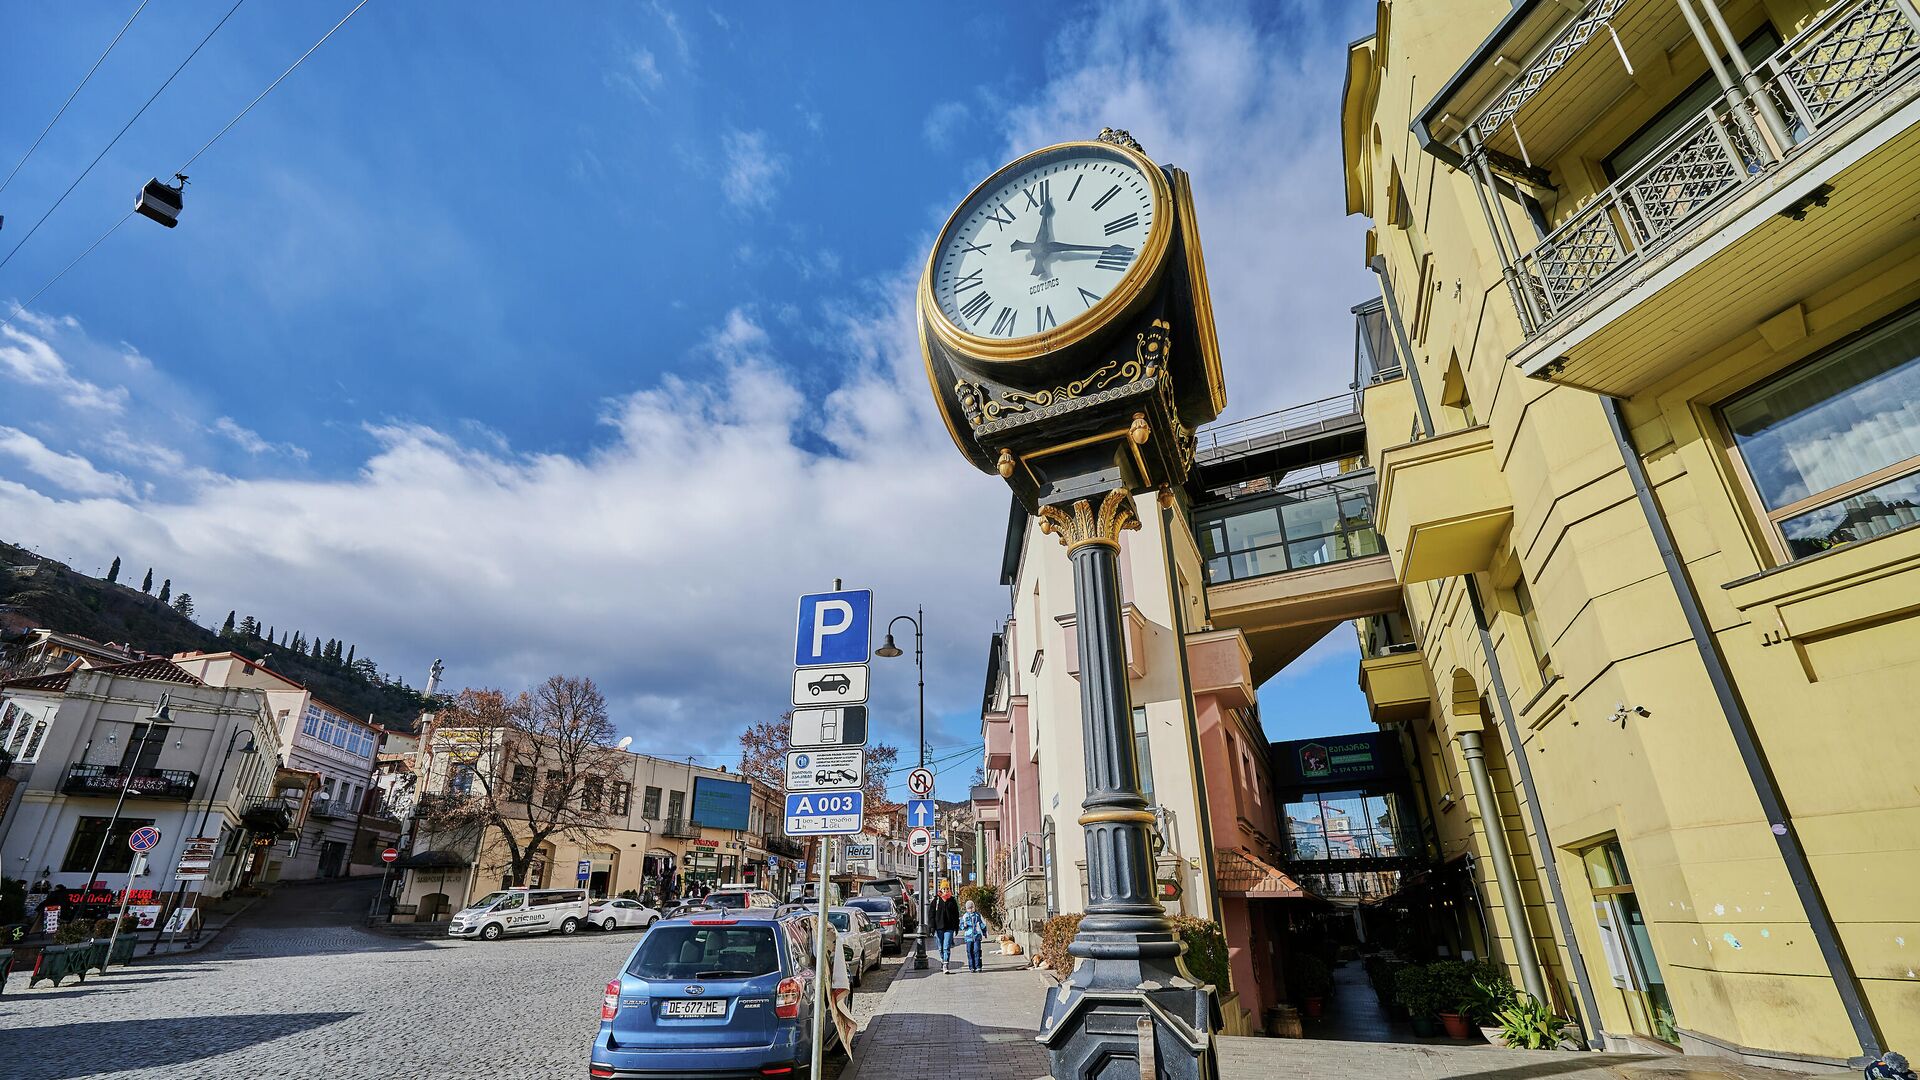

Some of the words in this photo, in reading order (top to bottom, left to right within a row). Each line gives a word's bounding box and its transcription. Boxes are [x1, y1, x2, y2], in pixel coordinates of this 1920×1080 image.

[811, 599, 854, 657] P
[795, 796, 814, 814] A
[818, 796, 853, 812] 003
[794, 818, 802, 830] 1
[821, 817, 829, 829] 1
[847, 846, 871, 856] Hertz
[669, 1002, 718, 1014] DE-677-ME
